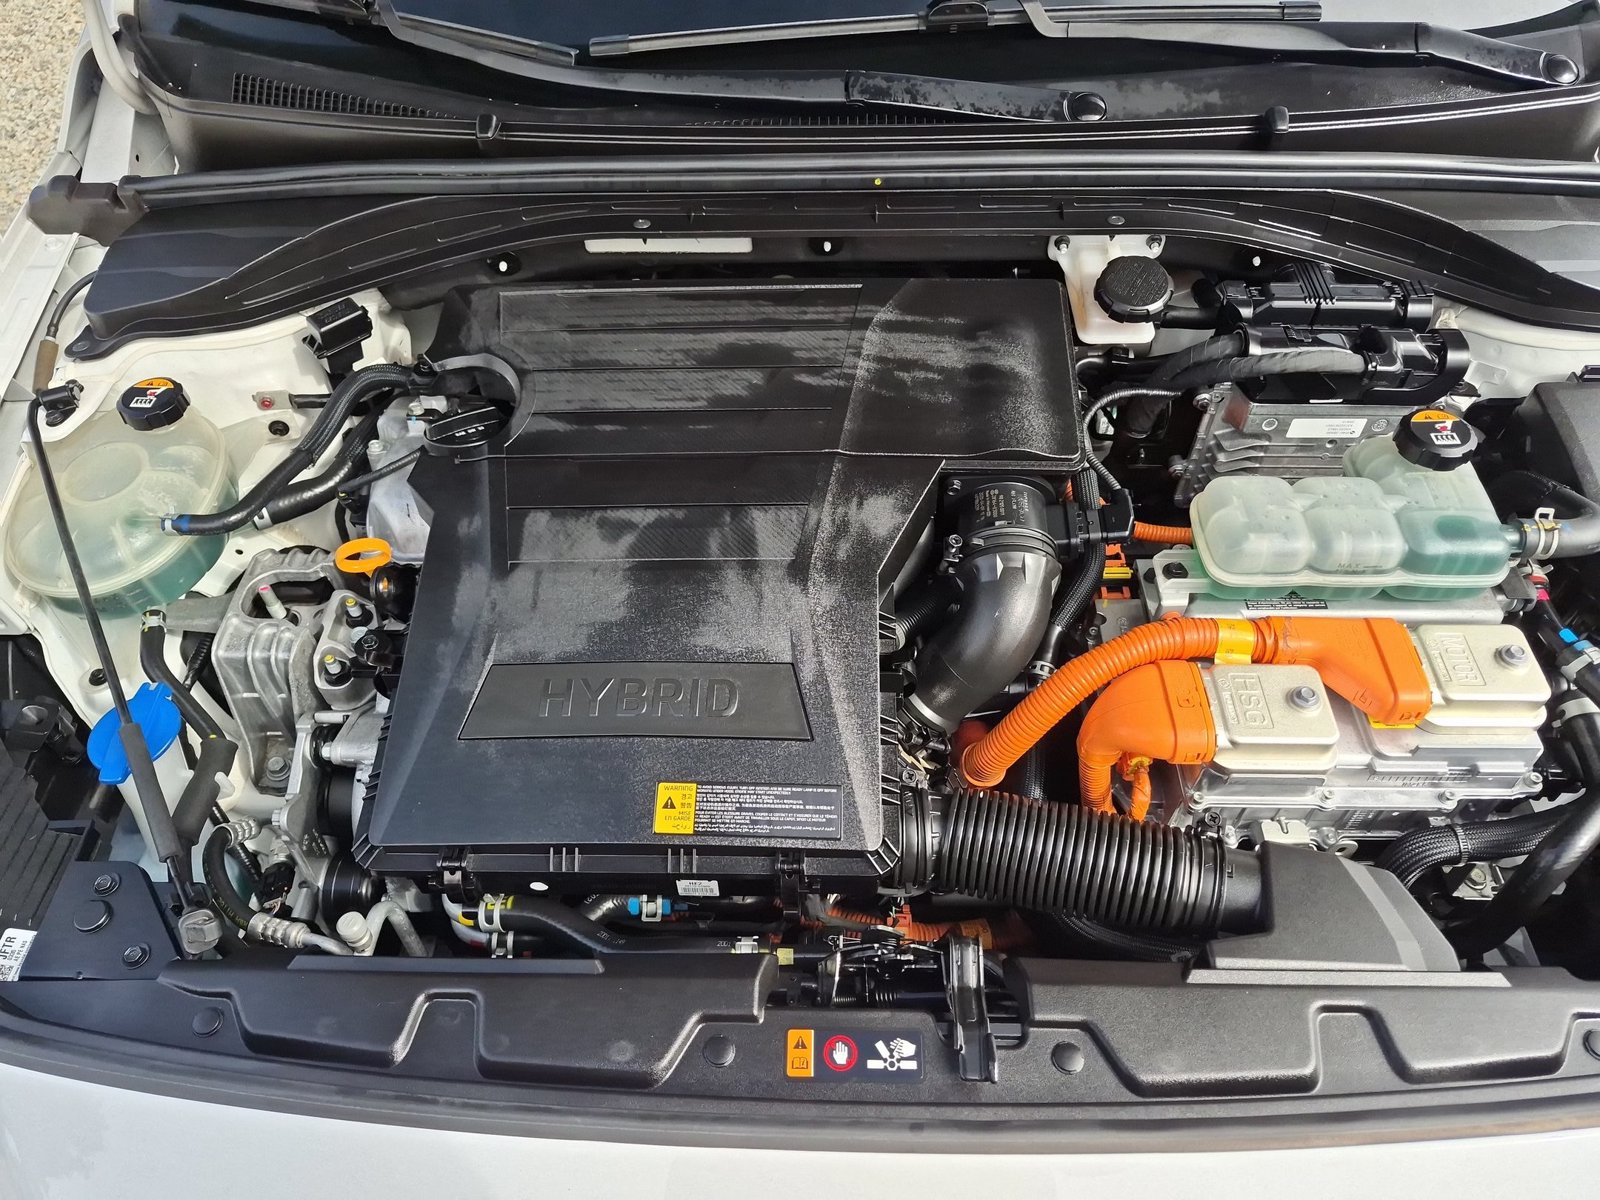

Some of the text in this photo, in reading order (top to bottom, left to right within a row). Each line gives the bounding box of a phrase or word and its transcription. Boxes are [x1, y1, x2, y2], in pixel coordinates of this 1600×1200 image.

[1440, 637, 1478, 682] MOTOR
[538, 677, 740, 718] HYBRID
[1232, 677, 1268, 726] HSG
